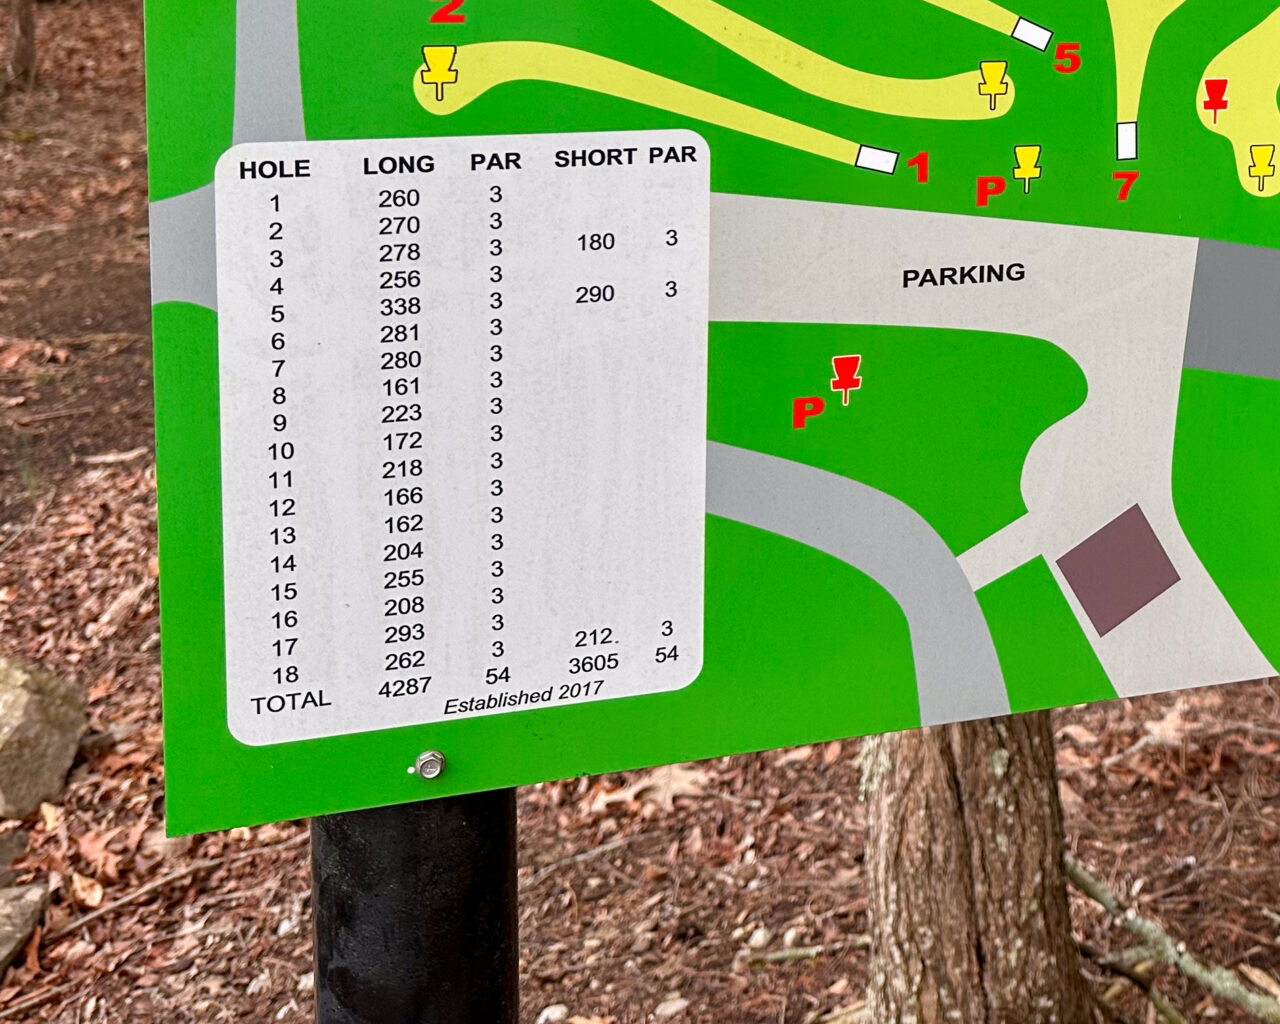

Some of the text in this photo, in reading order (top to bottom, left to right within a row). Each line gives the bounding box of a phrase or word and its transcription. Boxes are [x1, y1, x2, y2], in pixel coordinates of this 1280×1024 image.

[1053, 42, 1082, 74] 5
[238, 145, 699, 180] HOLE LONG PAR SHORT PAR
[907, 152, 930, 184] 1
[270, 185, 503, 213] 1 260 3
[976, 176, 1007, 208] P
[1113, 171, 1140, 202] 7
[268, 211, 503, 241] 2 270 3
[269, 229, 679, 268] 3 278 3 180 3
[269, 265, 503, 295] 4 256 3
[902, 263, 1027, 289] PARKING
[271, 280, 678, 323] 5 338 3 290 3
[271, 318, 503, 351] 6 281 3
[271, 344, 503, 378] 7 280 3
[272, 370, 503, 405] 8 161 3
[272, 397, 504, 432] 9 223 3
[792, 396, 825, 430] P
[268, 424, 504, 461] 10 172 3
[268, 451, 504, 489] 11 218 3
[269, 479, 504, 518] 12 166 3
[269, 506, 504, 546] 13 162 3
[270, 533, 504, 574] 14 204 3
[271, 560, 505, 602] 15 255 3
[271, 587, 505, 629] 16 208 3
[272, 613, 505, 657] 17 293 3
[272, 665, 300, 685] 18
[384, 650, 426, 672] 262
[491, 640, 505, 658] 3
[661, 620, 674, 637] 3
[250, 644, 680, 715] TOTAL 4287 54 3605 54
[443, 680, 605, 715] Established 2017
